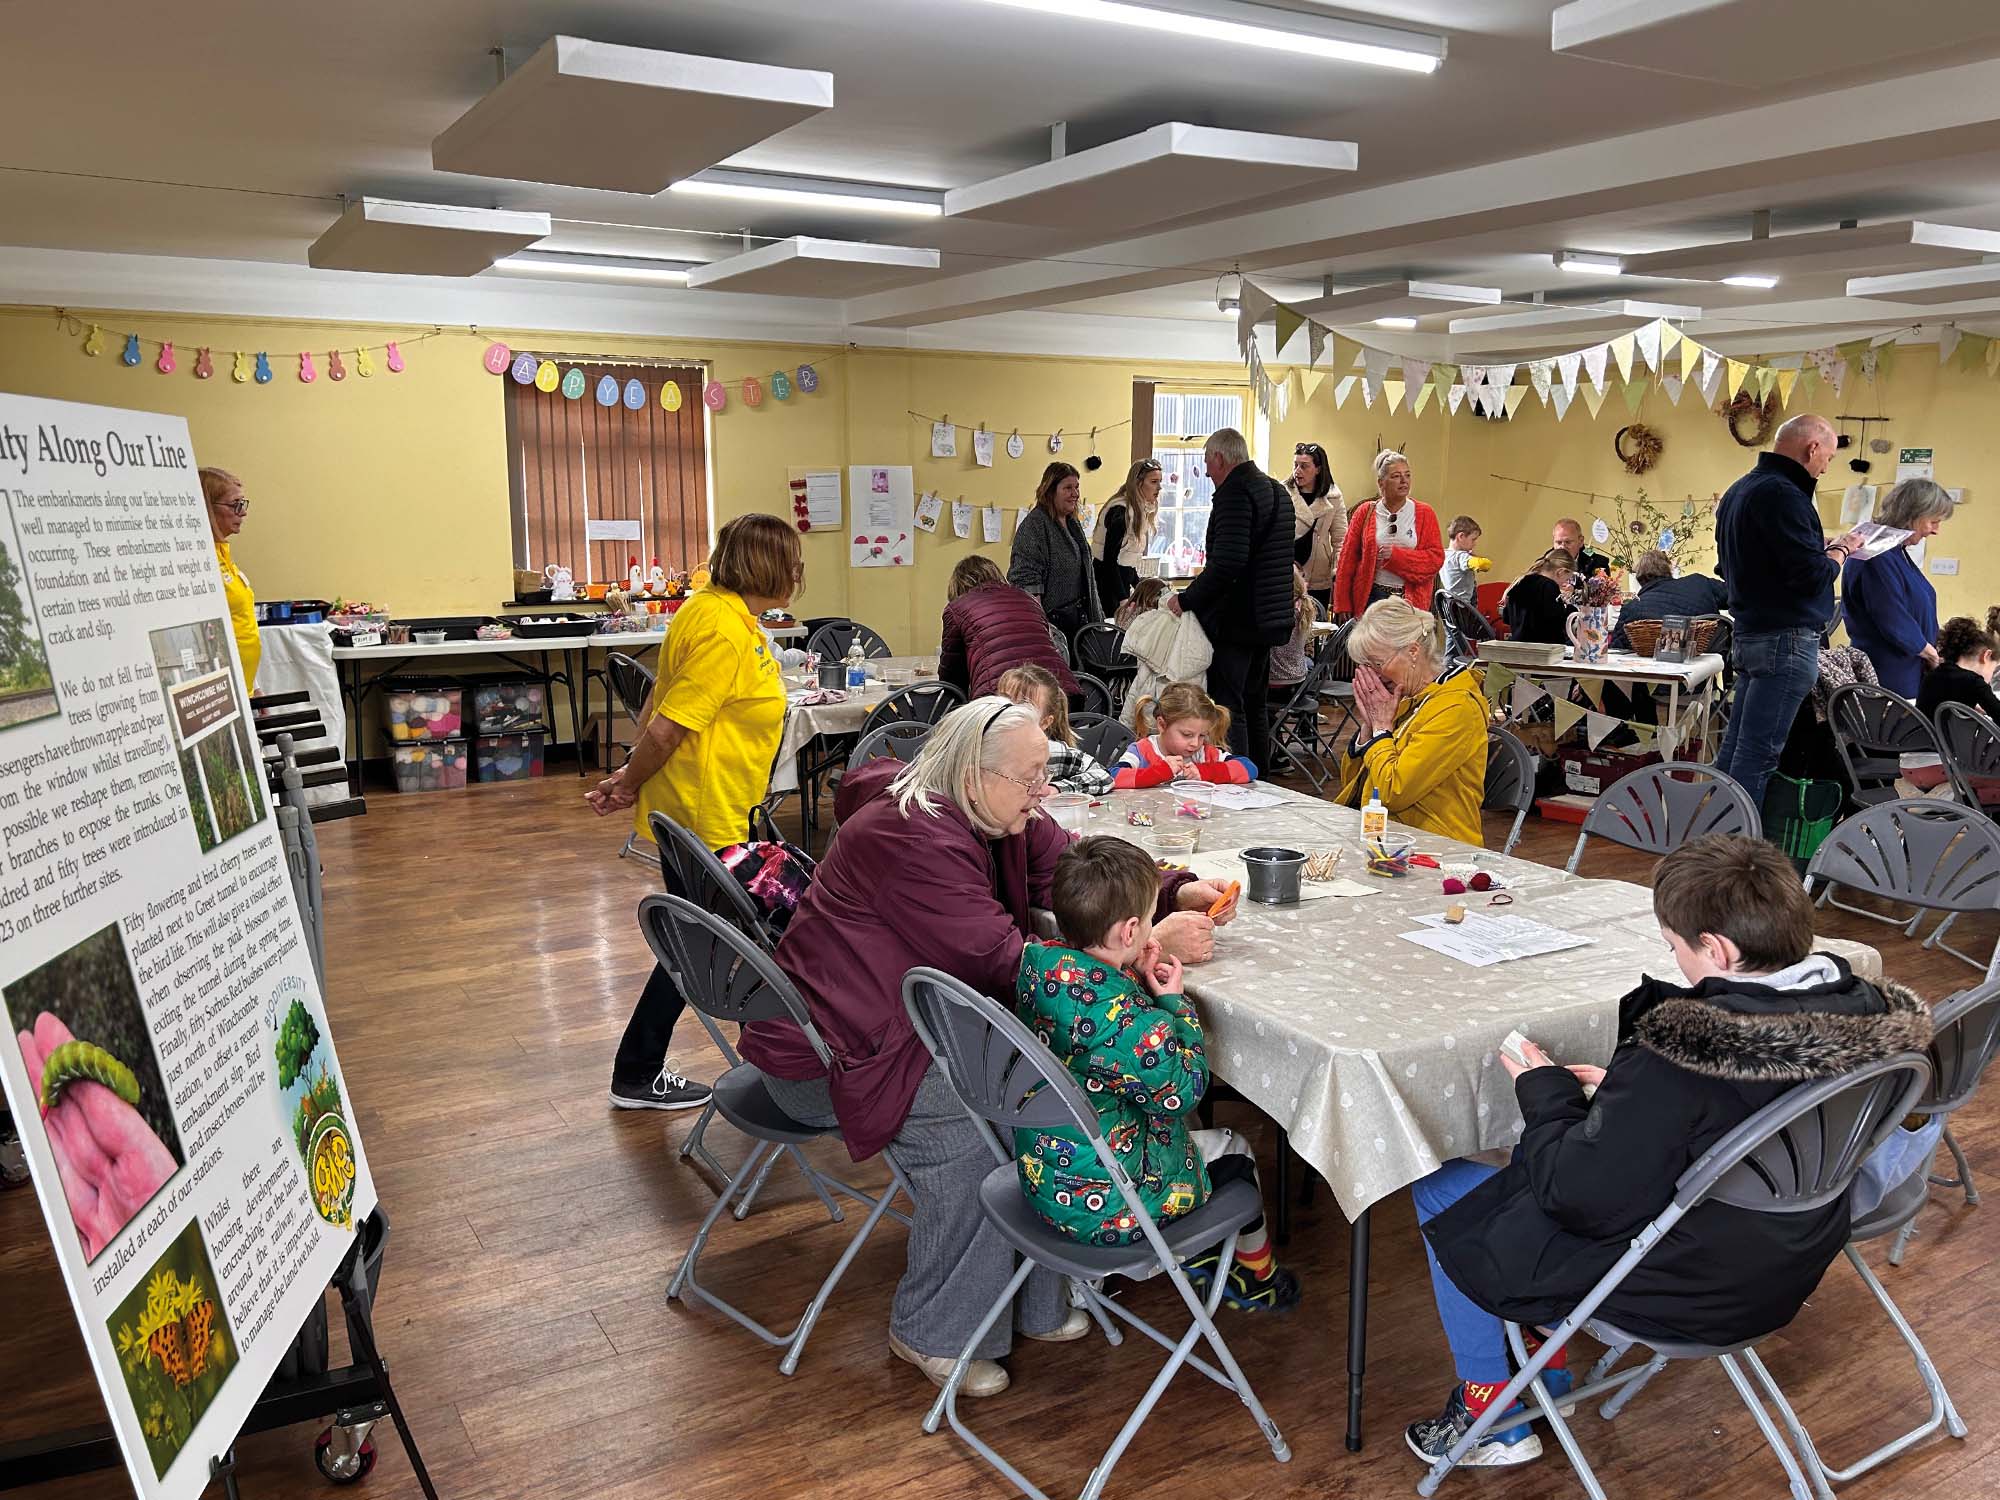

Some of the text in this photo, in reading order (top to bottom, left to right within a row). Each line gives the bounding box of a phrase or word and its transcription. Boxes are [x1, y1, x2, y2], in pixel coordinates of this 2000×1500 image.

[491, 349, 613, 401] HAPPY
[38, 424, 107, 477] Along
[106, 431, 146, 466] Our
[145, 435, 188, 469] Line
[13, 490, 177, 511] The embankments along our line have
[21, 514, 201, 538] well managed minimise the risk slips
[28, 537, 193, 566] occurring. These embankments have
[34, 559, 202, 591] foundation and the height and weight
[41, 581, 207, 618] certain trees would often cause the land
[48, 619, 116, 645] crack and slip.
[60, 662, 154, 699] We not fell fruit
[67, 688, 160, 726] trees (growing from
[23, 781, 43, 800] the
[46, 764, 89, 792] window
[92, 752, 123, 775] whilst
[44, 744, 71, 763] have
[70, 732, 107, 755] thrown
[106, 722, 132, 746] apple
[131, 716, 148, 736] and
[147, 711, 166, 733] pear
[2, 808, 49, 847] possible
[70, 788, 109, 809] reshape
[138, 758, 178, 786] removing
[7, 838, 60, 871] branches
[78, 813, 112, 841] expose
[115, 804, 130, 823] the
[164, 782, 183, 800] One
[0, 877, 30, 909] dred
[33, 865, 55, 892] and
[56, 855, 79, 880] fifty
[82, 846, 107, 867] trees
[109, 833, 131, 854] were
[132, 805, 178, 843] introduced
[122, 834, 273, 936] Fifty flowering and bird cherry trees were
[0, 868, 124, 944] 23 three further sites.
[131, 855, 278, 961] planted next Greet tunnel encourage
[138, 963, 153, 984] the
[154, 950, 171, 976] bird
[184, 930, 204, 952] This
[203, 915, 219, 939] will
[217, 907, 233, 930] also
[231, 900, 247, 924] give
[249, 883, 268, 906] visual
[266, 873, 284, 893] effect
[146, 894, 288, 1009] when observing the pink blossom when
[153, 1003, 184, 1036] exiting
[183, 990, 197, 1011] the
[198, 974, 222, 1002] tunnel
[223, 950, 247, 980] during
[246, 940, 258, 959] the
[258, 926, 280, 952] spring
[190, 1010, 207, 1036] fifty
[228, 980, 244, 1003] Red
[242, 964, 263, 991] bushes
[262, 953, 279, 970] were
[275, 931, 299, 964] planted
[167, 993, 260, 1090] just north Winchcombe
[264, 975, 307, 1028] BIODIVERSITY
[213, 1045, 235, 1073] offset
[239, 1021, 260, 1049] recent
[181, 1076, 230, 1133] embankment
[246, 1043, 262, 1068] Bird
[188, 1076, 260, 1160] and insect boxes will
[93, 1150, 226, 1297] installed each our stations.
[203, 1135, 284, 1235] Whilst there are
[210, 1156, 291, 1260] housing developments
[274, 1190, 288, 1212] the
[285, 1170, 299, 1196] land
[226, 1263, 254, 1306] around
[255, 1244, 269, 1266] the
[232, 1209, 315, 1331] believe that important
[249, 1303, 276, 1347] manage
[273, 1286, 286, 1308] the
[284, 1262, 299, 1287] land
